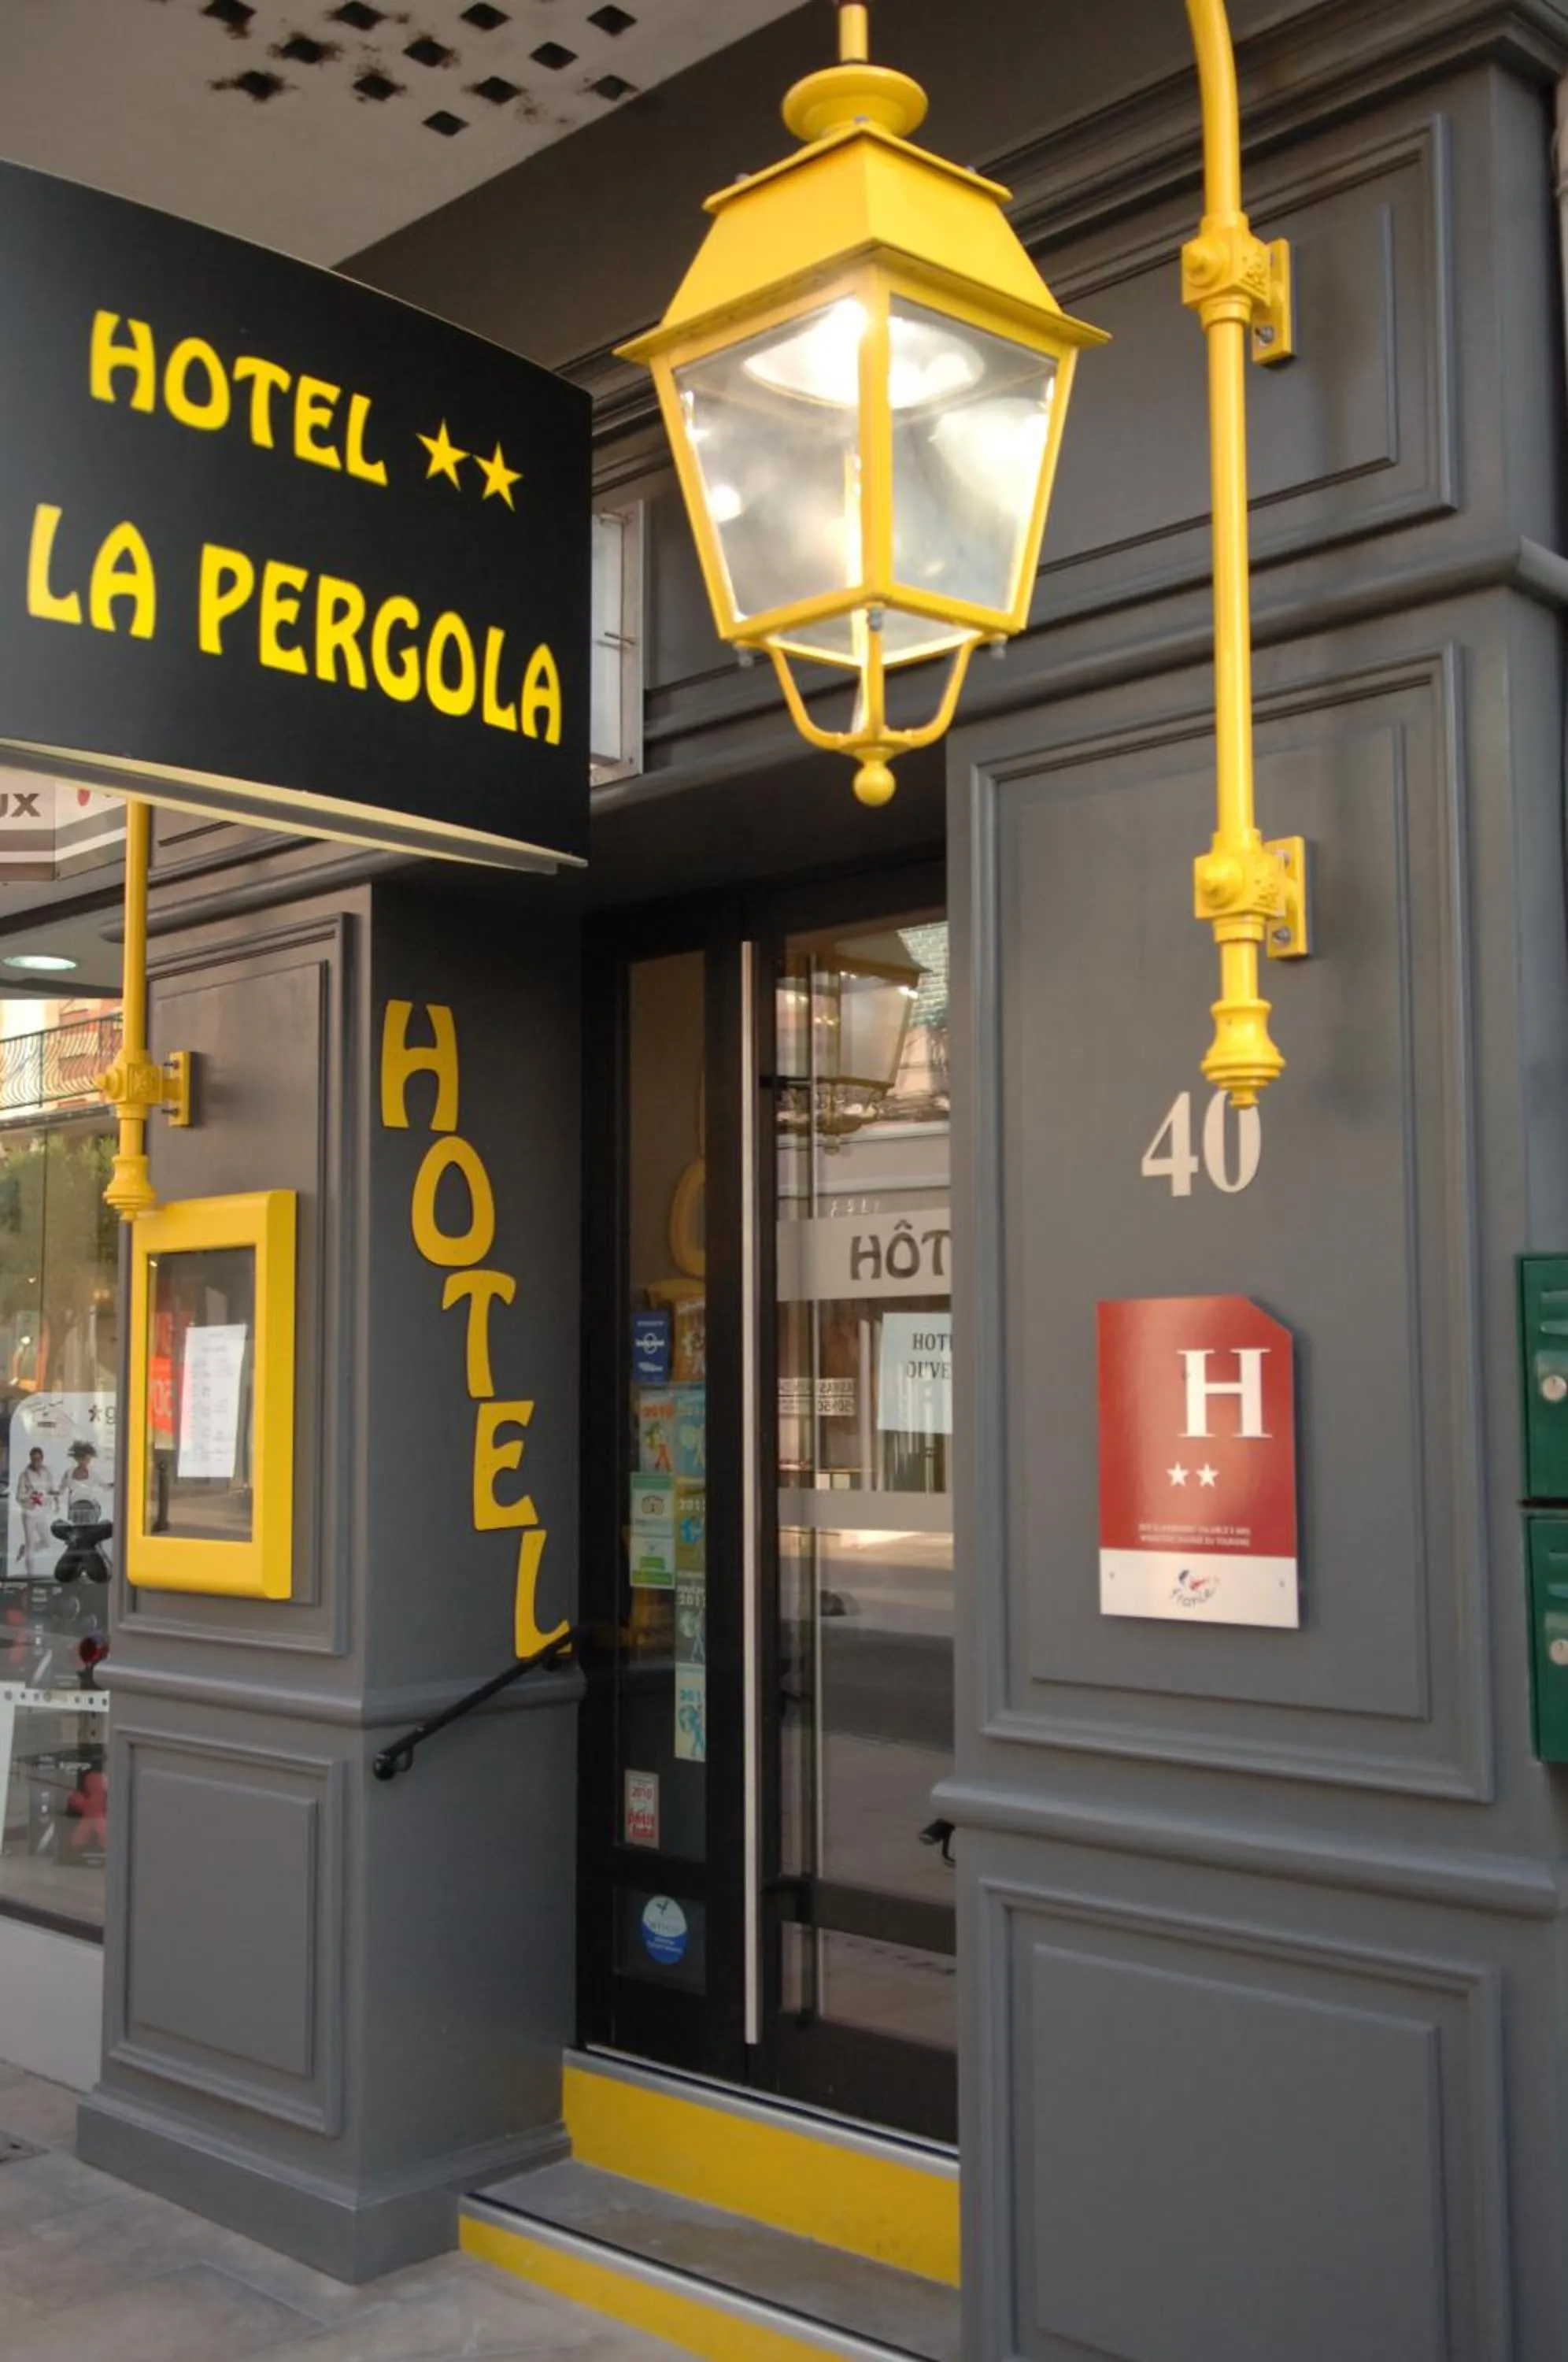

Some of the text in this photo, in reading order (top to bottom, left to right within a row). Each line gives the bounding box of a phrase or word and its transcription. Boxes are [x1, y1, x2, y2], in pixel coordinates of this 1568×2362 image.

[90, 309, 388, 486] HOTEL
[28, 504, 561, 746] LA PERGOLA
[1141, 1090, 1260, 1197] 40
[849, 1219, 952, 1280] HÔT
[381, 1000, 572, 1659] HOTEL
[1178, 1347, 1273, 1439] H
